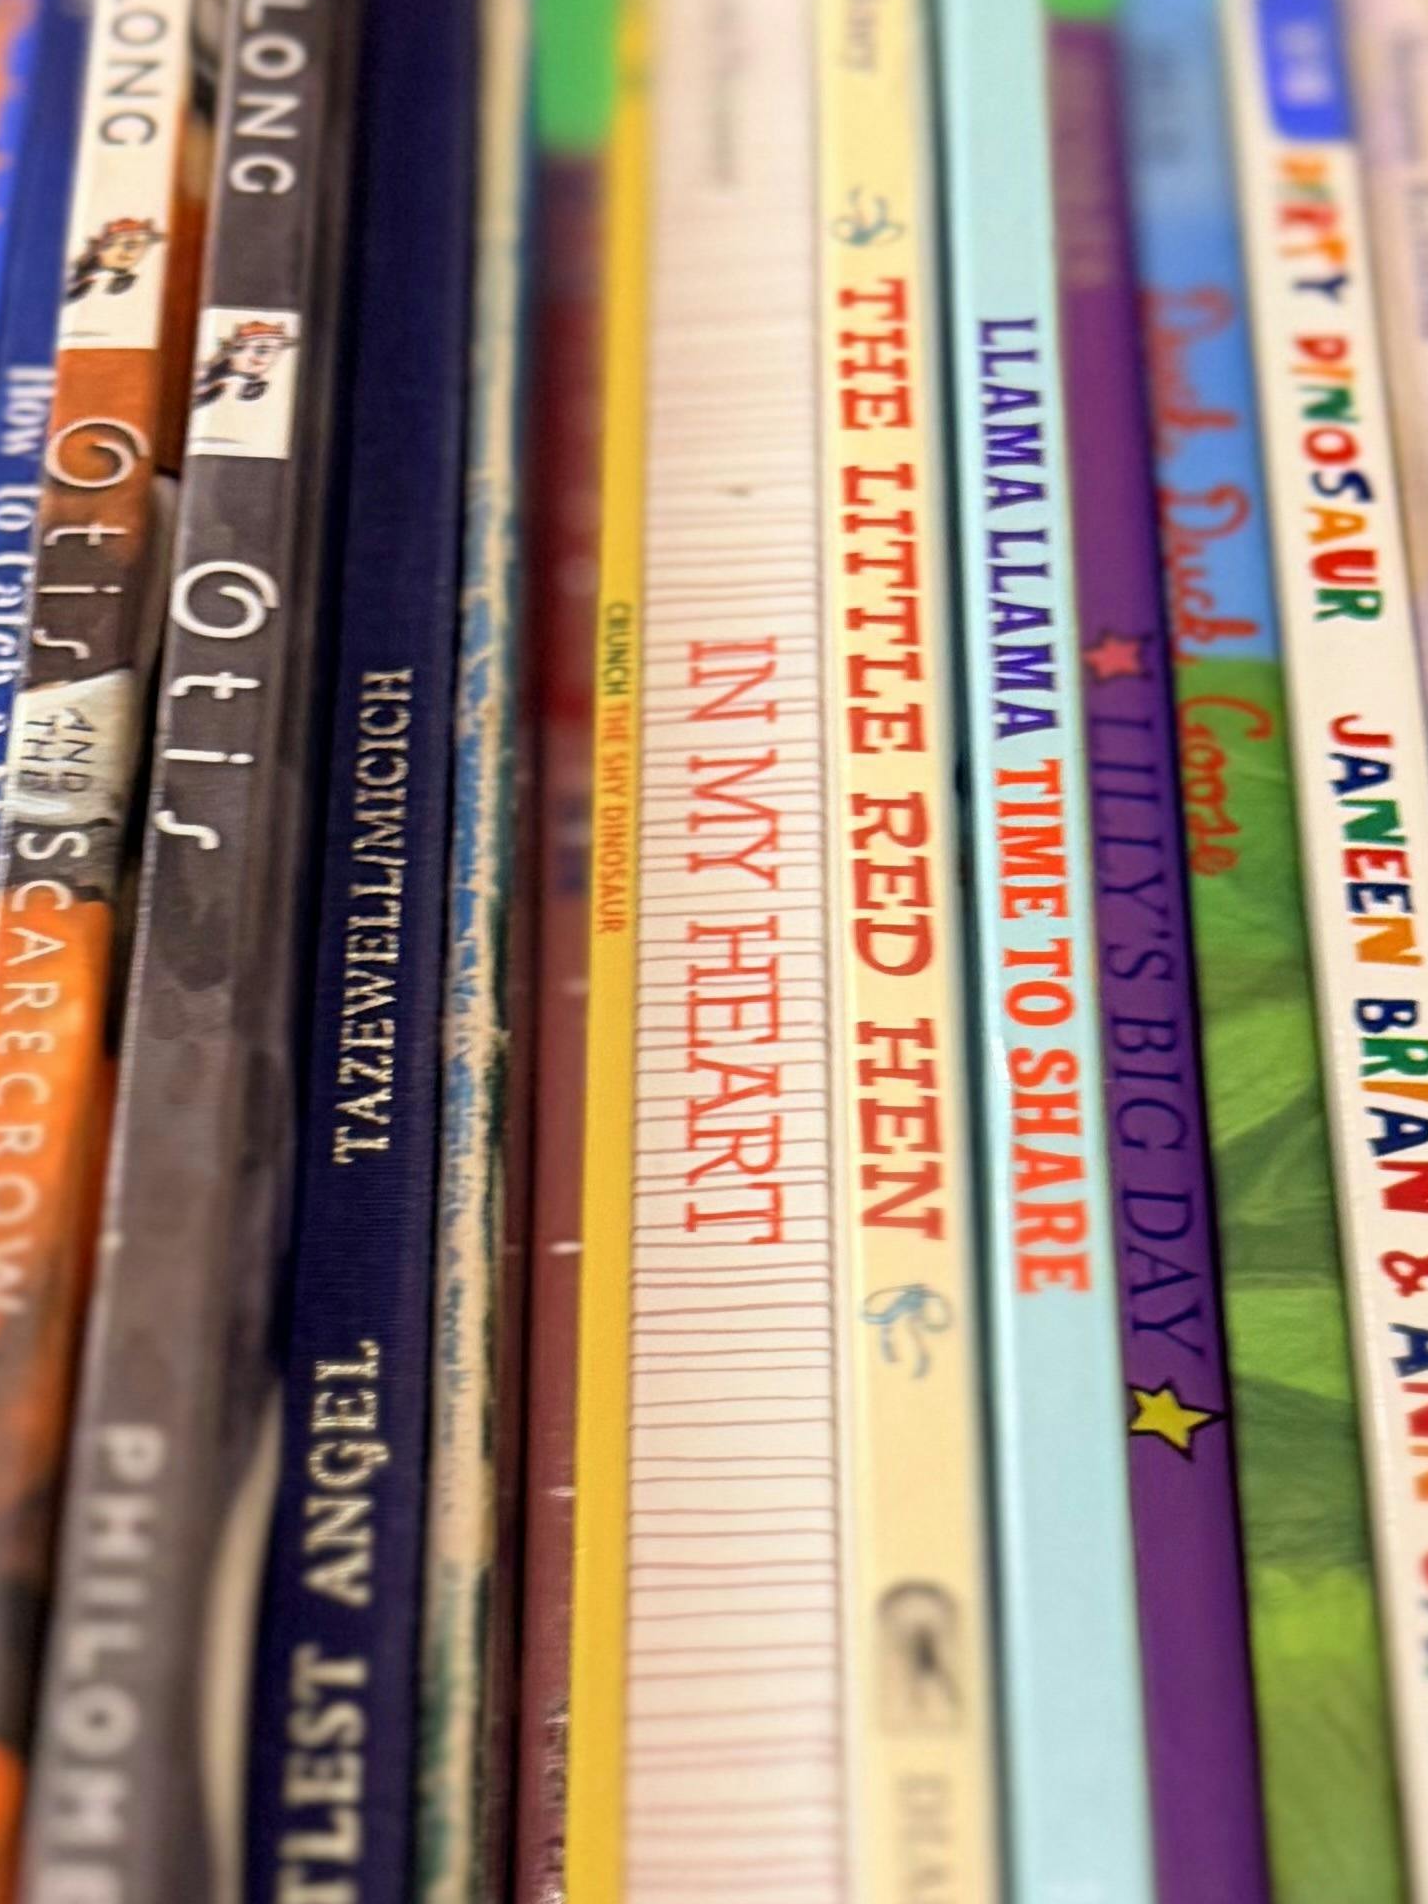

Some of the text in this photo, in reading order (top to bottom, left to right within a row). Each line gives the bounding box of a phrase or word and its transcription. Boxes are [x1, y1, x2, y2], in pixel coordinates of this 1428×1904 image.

[1, 366, 57, 459] How
[31, 416, 151, 660] Otis
[1288, 332, 1385, 626] DINOSAUR
[18, 710, 60, 795] THE
[56, 706, 99, 795] AND
[155, 560, 281, 851] Otis
[591, 599, 635, 937] CRUNCH THE SHY DINOSAUR
[837, 277, 948, 1243] THE LITTLE RED HEN
[976, 317, 1091, 1297] LLAMA LLAMA TIME TO SHARE
[1327, 713, 1425, 968] JANEEN
[332, 667, 415, 1166] TAZEWELL/MICICH
[682, 634, 786, 1246] IN MY HEART
[1088, 712, 1205, 1361] LILLY'S BIG DAY
[302, 1337, 391, 1609] ANGEL
